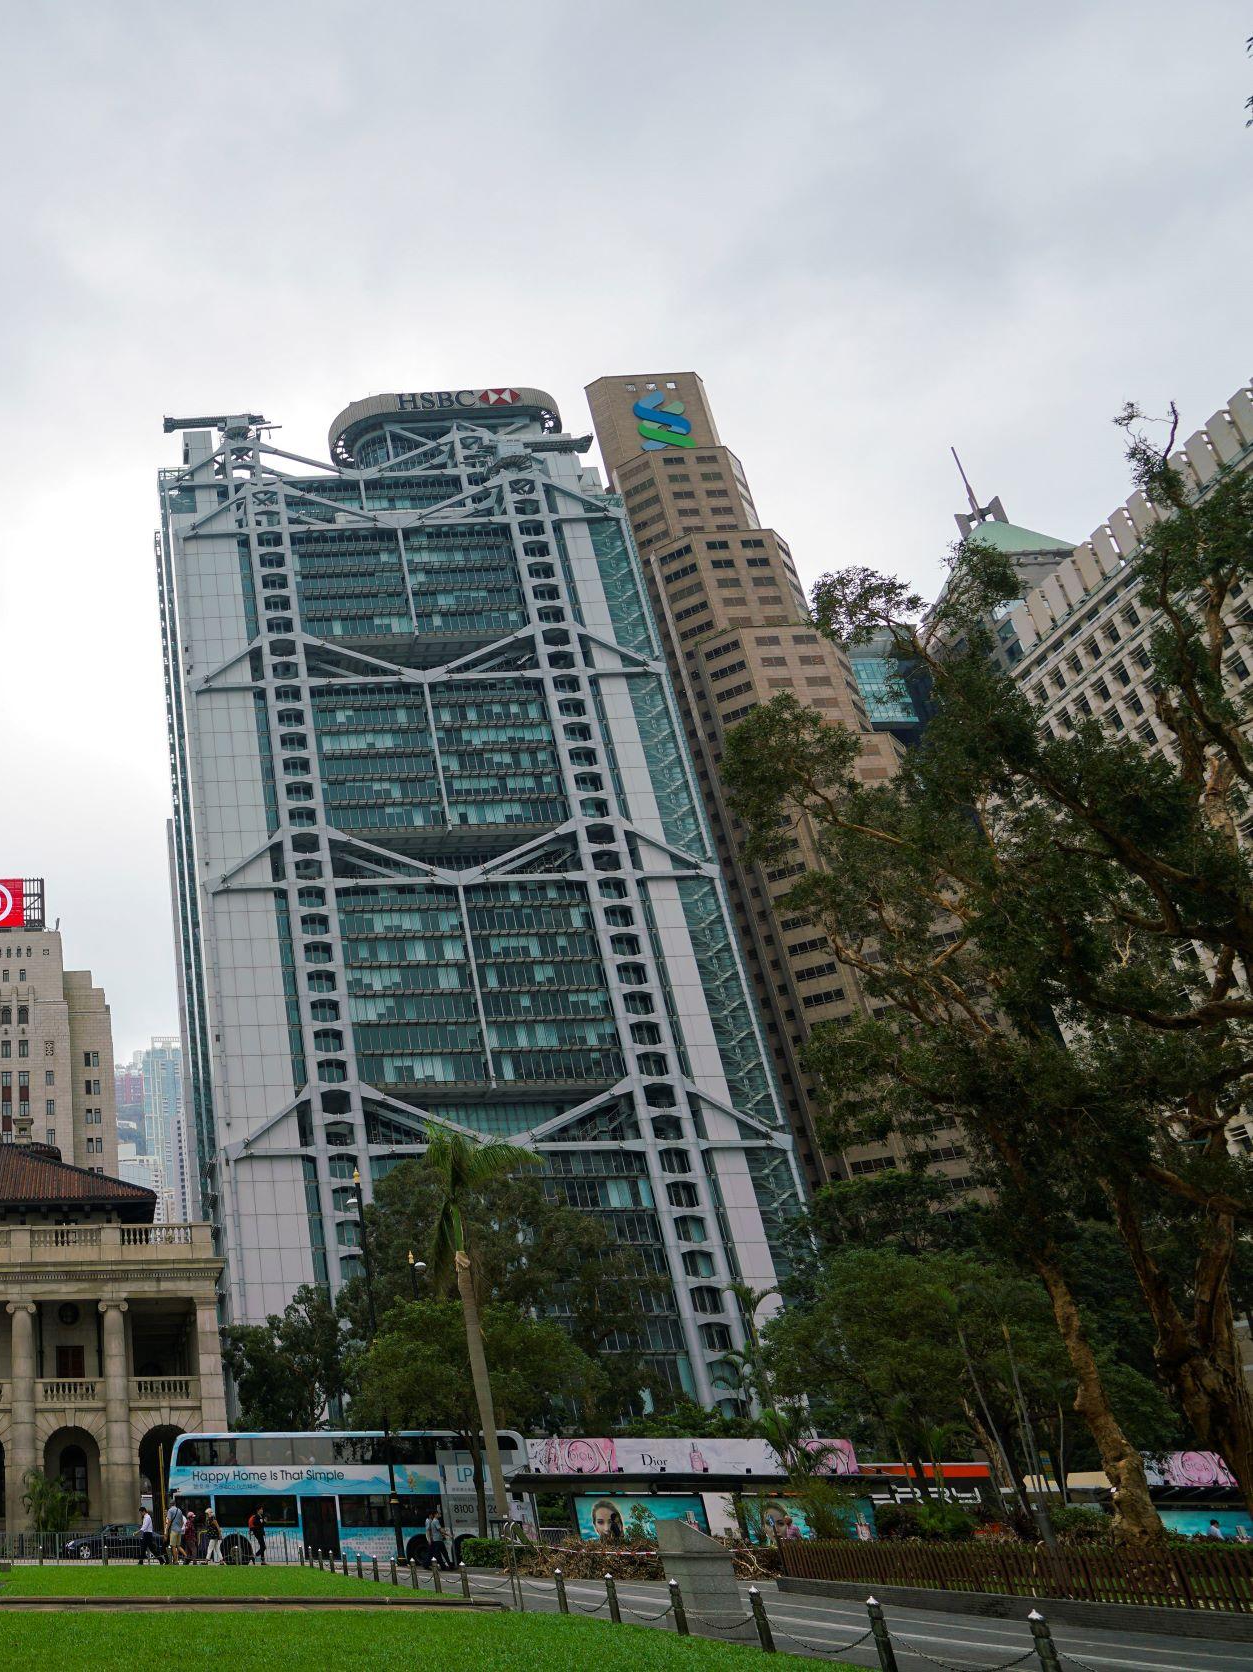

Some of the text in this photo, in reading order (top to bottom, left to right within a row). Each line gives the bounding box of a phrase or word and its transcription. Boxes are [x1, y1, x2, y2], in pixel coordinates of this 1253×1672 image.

[396, 390, 477, 410] HSBC
[640, 1453, 668, 1466] Dior
[192, 1469, 345, 1484] Happy Home Is That Simple
[454, 1504, 475, 1514] 8100
